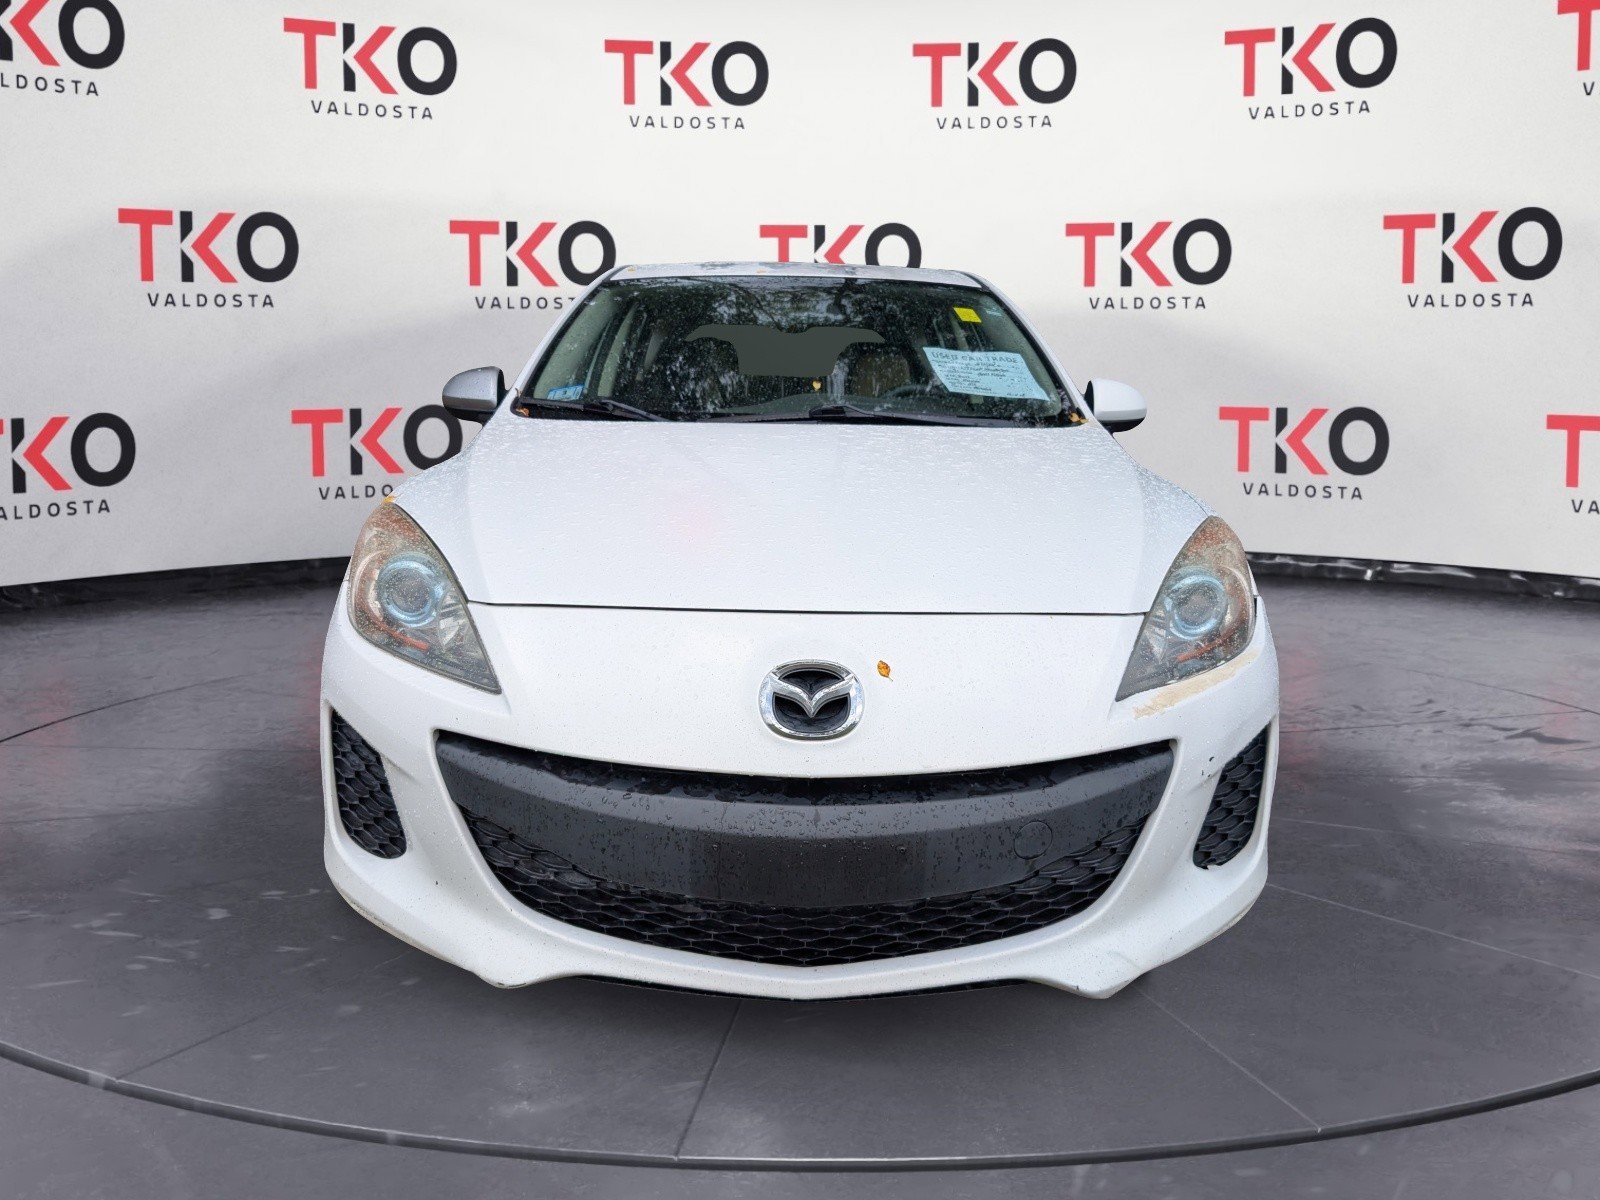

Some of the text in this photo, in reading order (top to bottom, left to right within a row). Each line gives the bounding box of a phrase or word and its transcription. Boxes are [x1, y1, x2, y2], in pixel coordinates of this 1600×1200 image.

[0, 0, 125, 69] KO
[283, 17, 457, 95] TKO
[1224, 17, 1398, 95] TKO
[0, 73, 98, 96] LDOSTA
[604, 39, 769, 107] TKO
[912, 38, 1077, 107] TKO
[311, 100, 433, 120] VALDOSTA
[629, 115, 745, 129] VALDOSTA
[936, 116, 1052, 129] VALDOSTA
[1248, 100, 1370, 120] VALDOSTA
[118, 208, 299, 283] TKO
[449, 220, 616, 287] TKO
[1065, 218, 1232, 287] TKO
[1383, 207, 1563, 284] TKO
[147, 292, 274, 308] VALDOSTA
[475, 297, 575, 310] VALDOS
[1089, 296, 1206, 310] VALDOSTA
[1407, 293, 1533, 308] VALDOSTA
[0, 413, 136, 494] KO
[291, 404, 463, 477] TKO
[1219, 406, 1390, 476] TKO
[0, 499, 110, 520] ALDOSTA
[318, 484, 393, 500] VALDO
[1243, 482, 1363, 500] VALDOSTA
